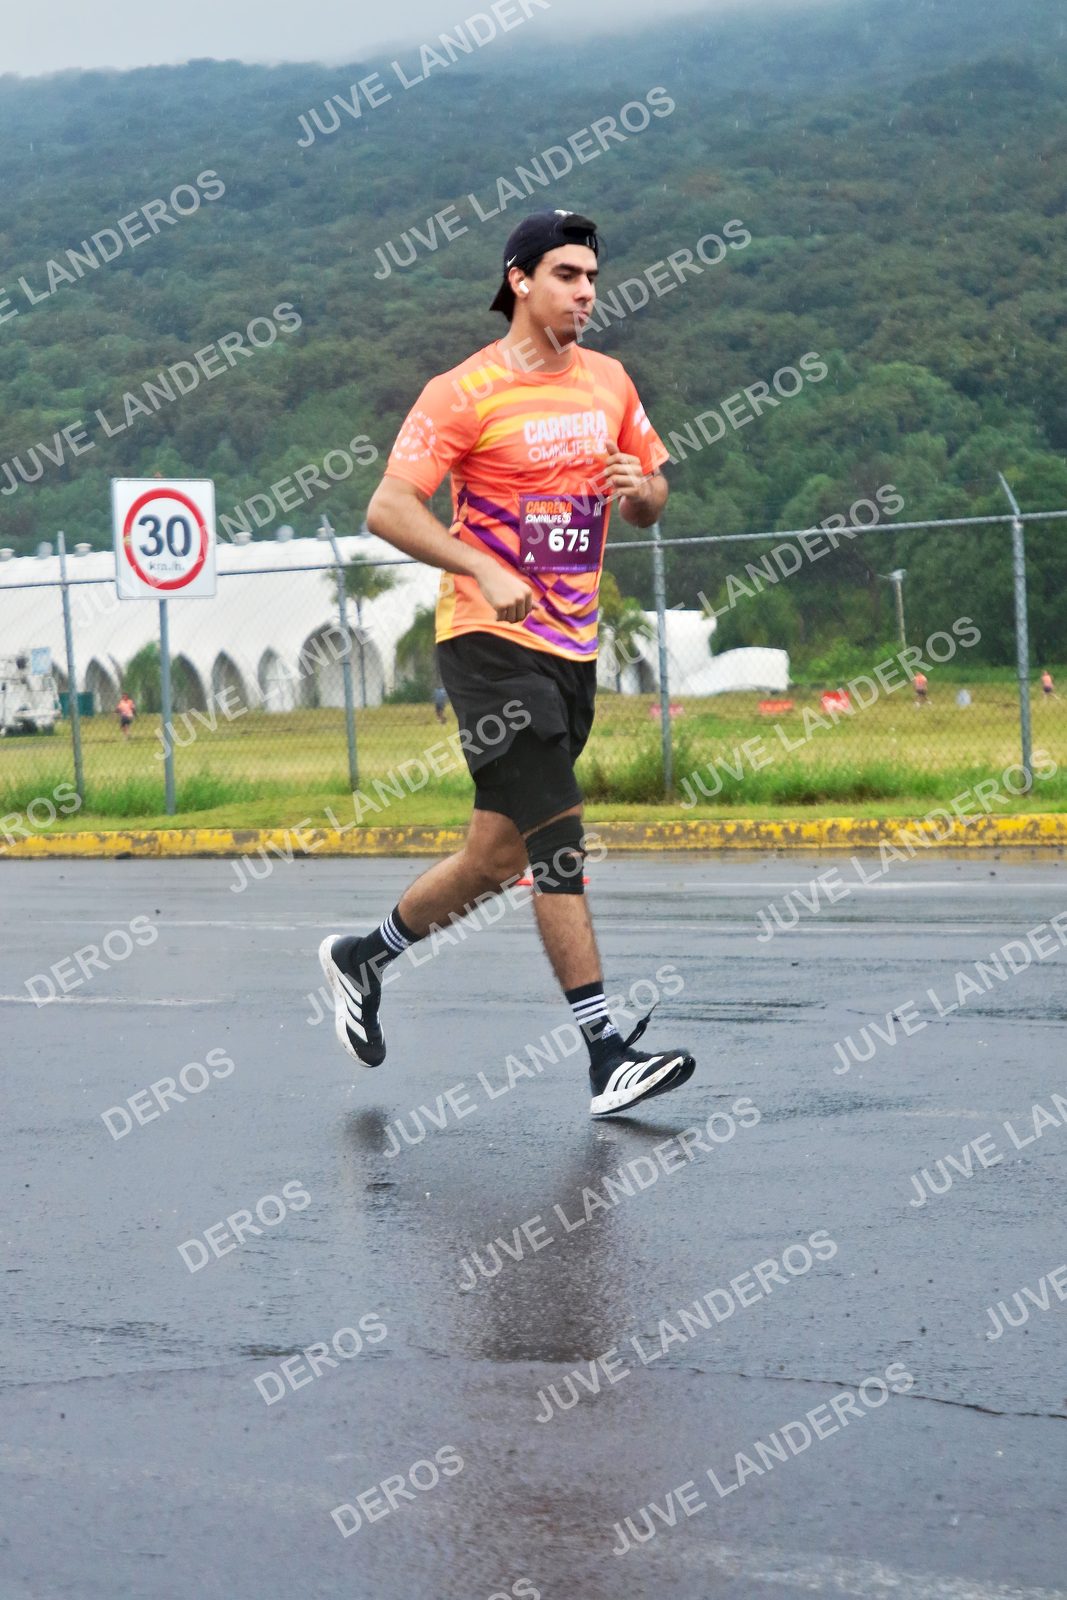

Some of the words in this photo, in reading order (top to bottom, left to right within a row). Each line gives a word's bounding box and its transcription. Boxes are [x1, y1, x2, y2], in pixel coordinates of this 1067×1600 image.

[523, 410, 608, 445] CARRERA
[528, 439, 593, 463] OMNILIFE
[525, 501, 572, 514] CARRERA
[138, 514, 192, 557] 30
[548, 528, 590, 552] 675
